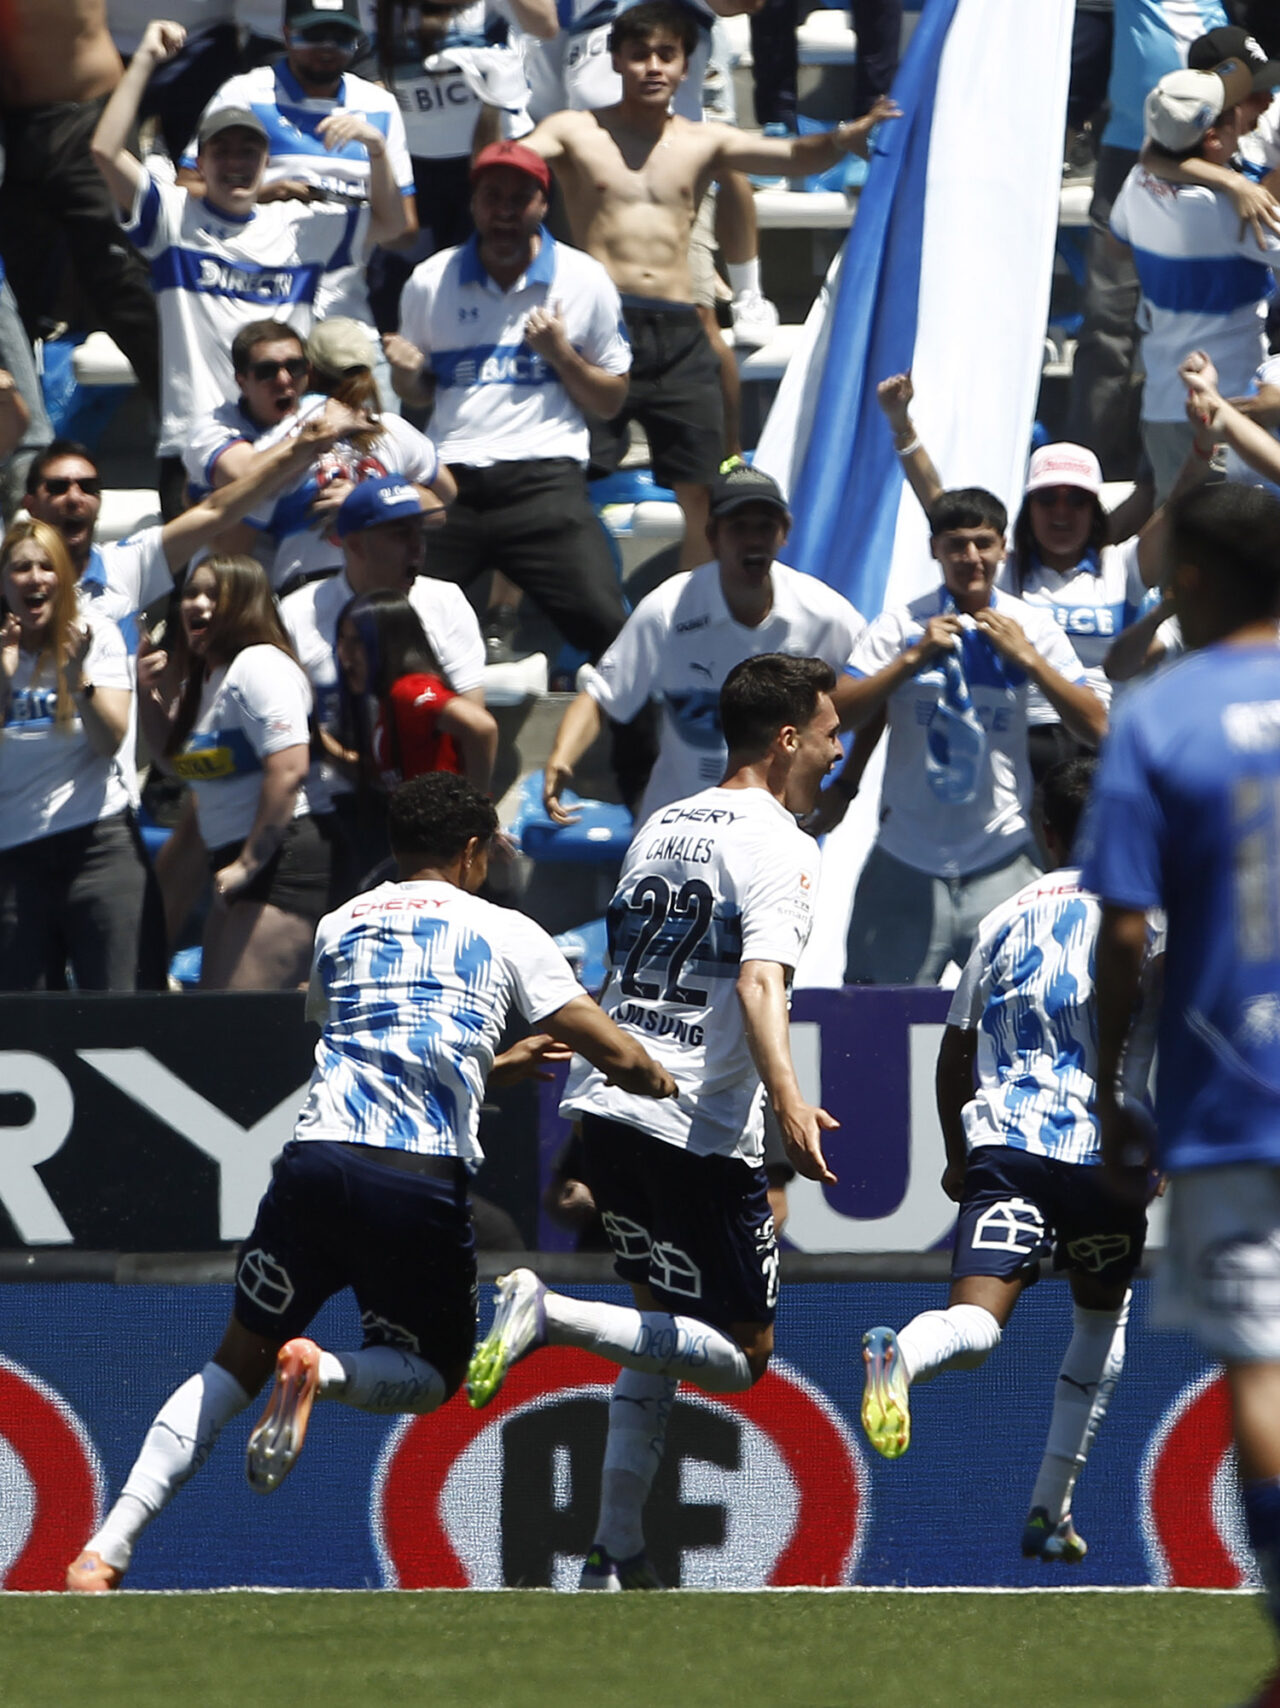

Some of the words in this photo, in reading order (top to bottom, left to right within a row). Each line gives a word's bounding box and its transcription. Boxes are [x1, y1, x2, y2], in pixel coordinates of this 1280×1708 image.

[416, 83, 478, 112] BIC
[1057, 606, 1115, 636] ICE
[13, 685, 60, 718] BIC
[661, 807, 747, 825] CHERY
[645, 836, 715, 864] CANALES
[351, 897, 451, 919] CHERY
[621, 875, 715, 1007] 22
[611, 1002, 704, 1047] AMSUNG
